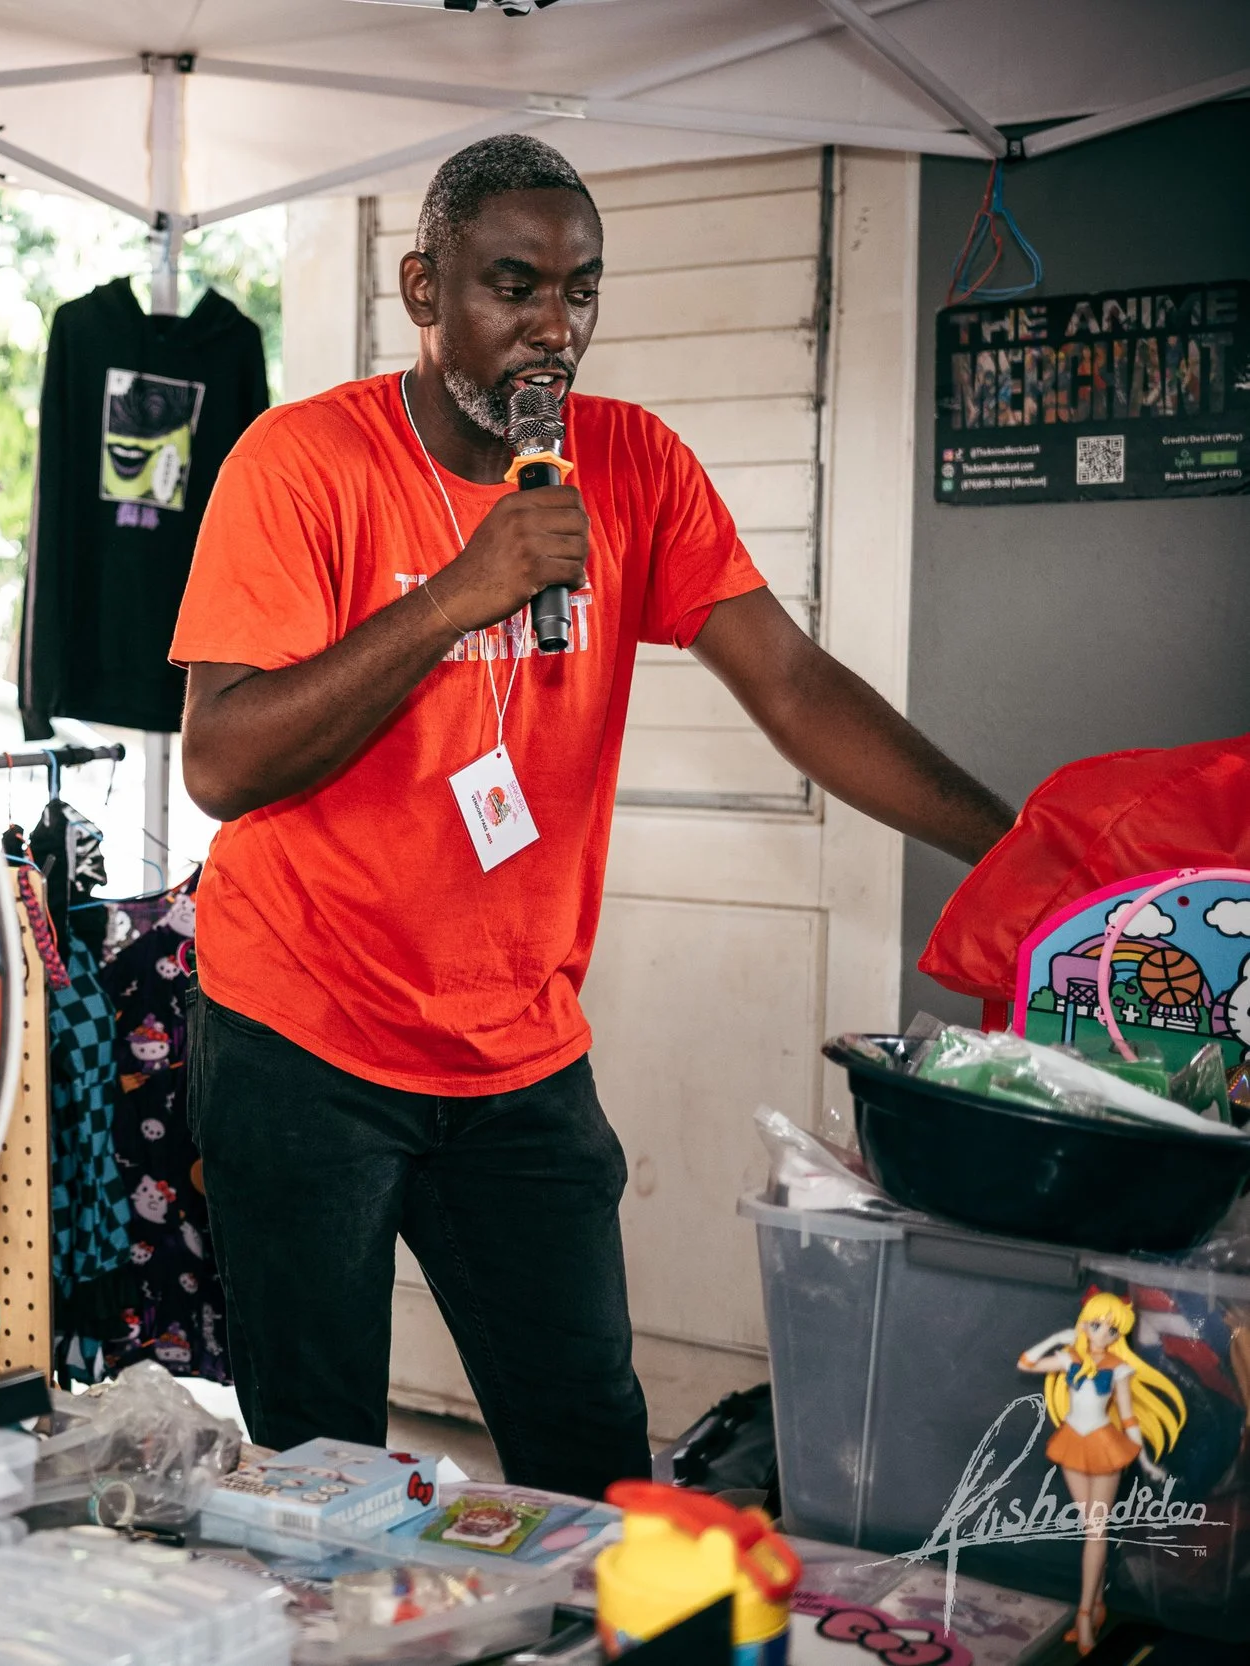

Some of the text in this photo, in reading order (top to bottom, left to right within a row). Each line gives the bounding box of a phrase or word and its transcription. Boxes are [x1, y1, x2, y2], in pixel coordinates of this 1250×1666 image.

[950, 289, 1238, 345] THE ANIME
[951, 331, 1234, 430] MERCHANT
[471, 794, 483, 819] VENDORS
[510, 780, 526, 812] SAKURA
